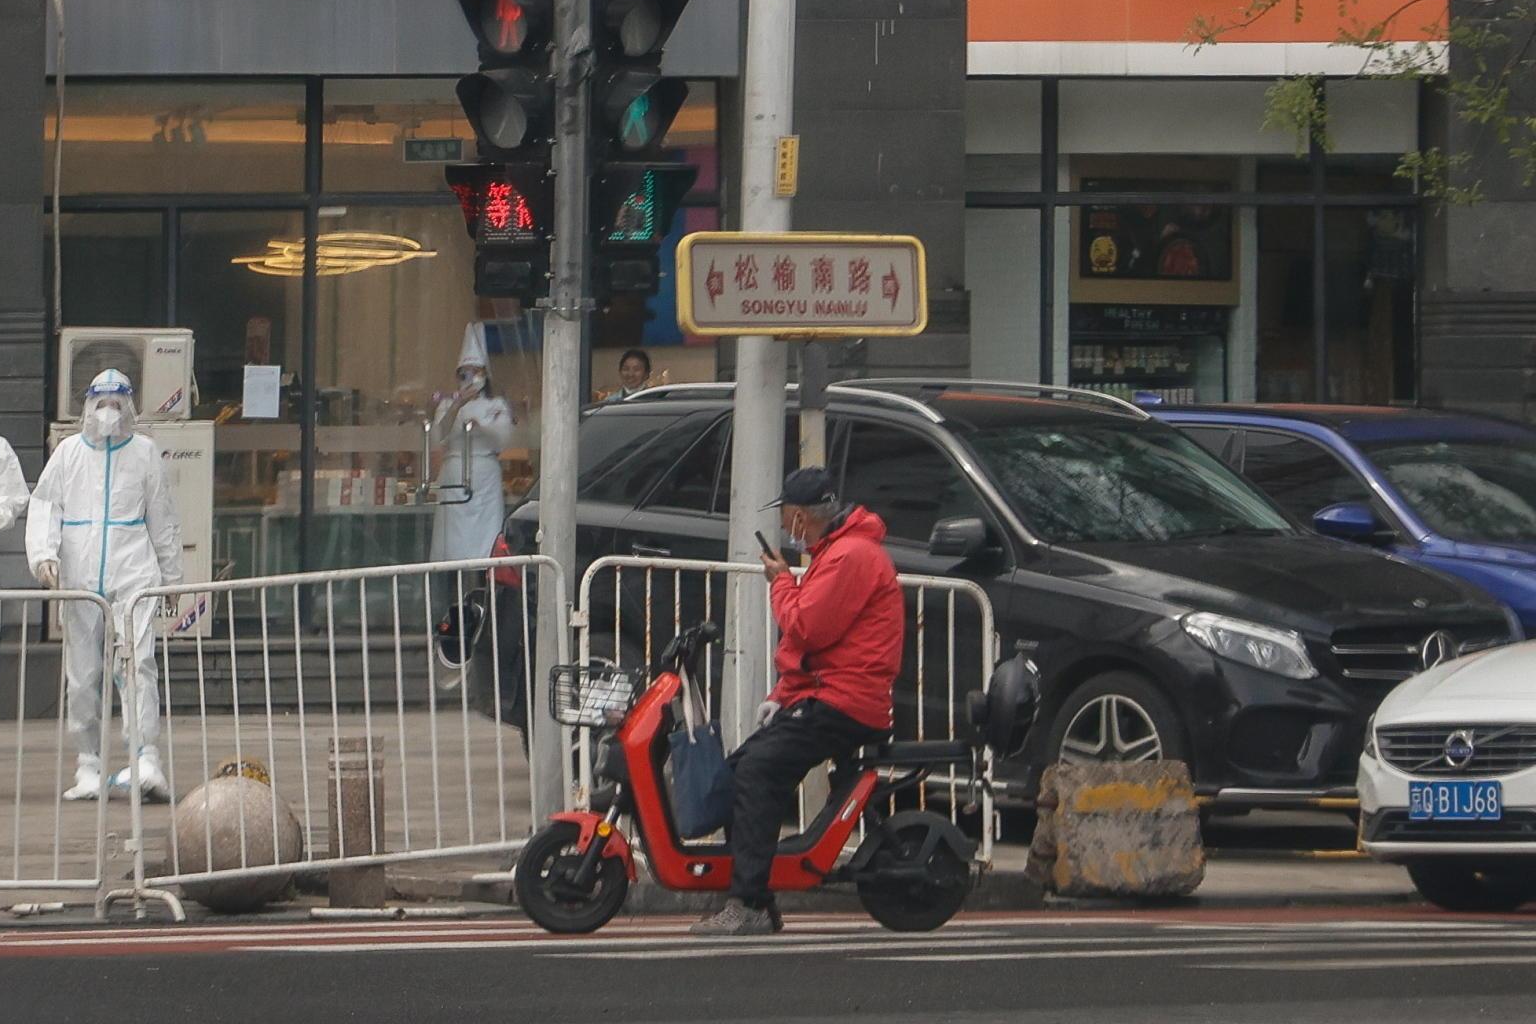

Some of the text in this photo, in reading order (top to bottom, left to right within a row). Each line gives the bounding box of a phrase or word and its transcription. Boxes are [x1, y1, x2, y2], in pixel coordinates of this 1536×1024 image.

[734, 253, 873, 296] 松榆南路
[741, 298, 808, 316] SONGYU
[171, 450, 204, 460] GREE
